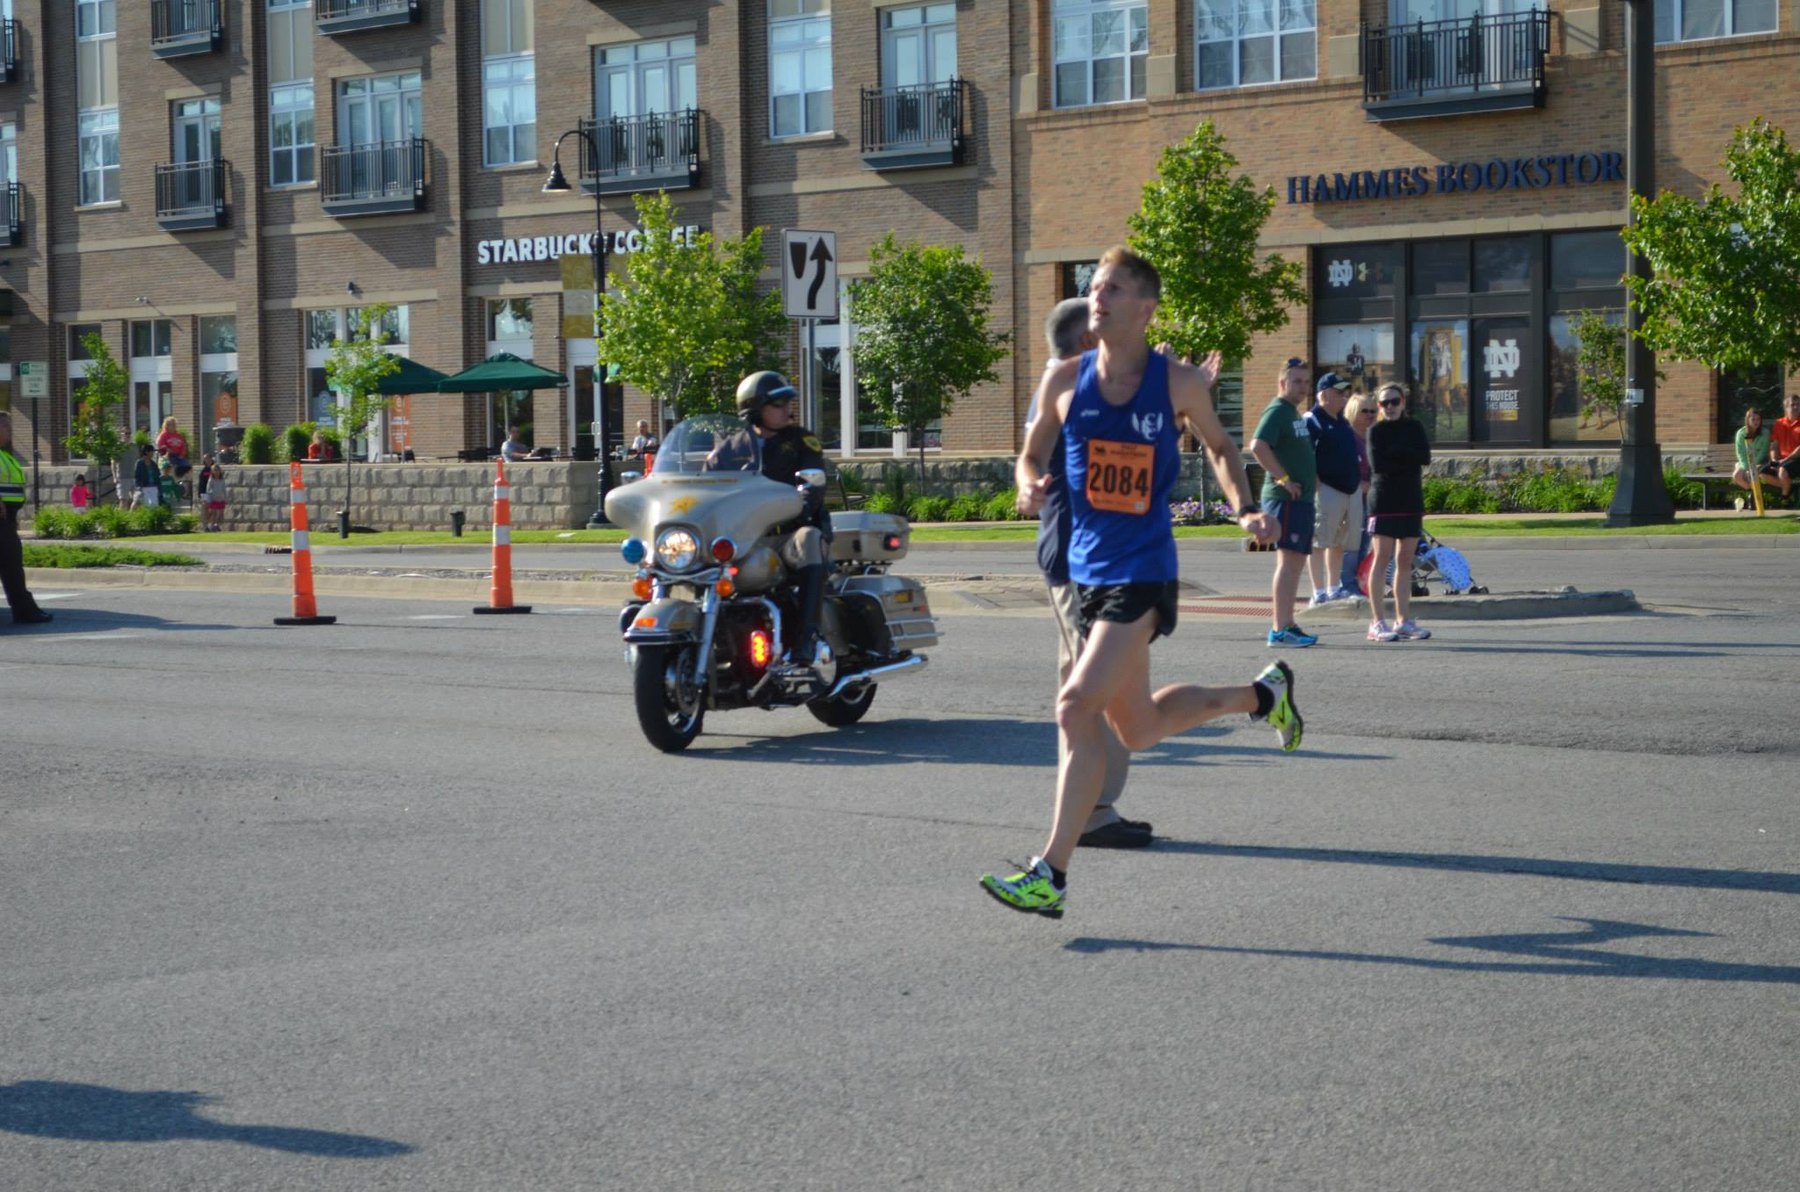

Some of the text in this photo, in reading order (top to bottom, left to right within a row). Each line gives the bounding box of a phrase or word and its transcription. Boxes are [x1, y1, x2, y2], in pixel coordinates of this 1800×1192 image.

[1287, 151, 1626, 204] HAMMES BOOKSTOR
[613, 224, 699, 254] COEE
[1485, 389, 1519, 401] PROTECT
[1089, 461, 1149, 497] 2084
